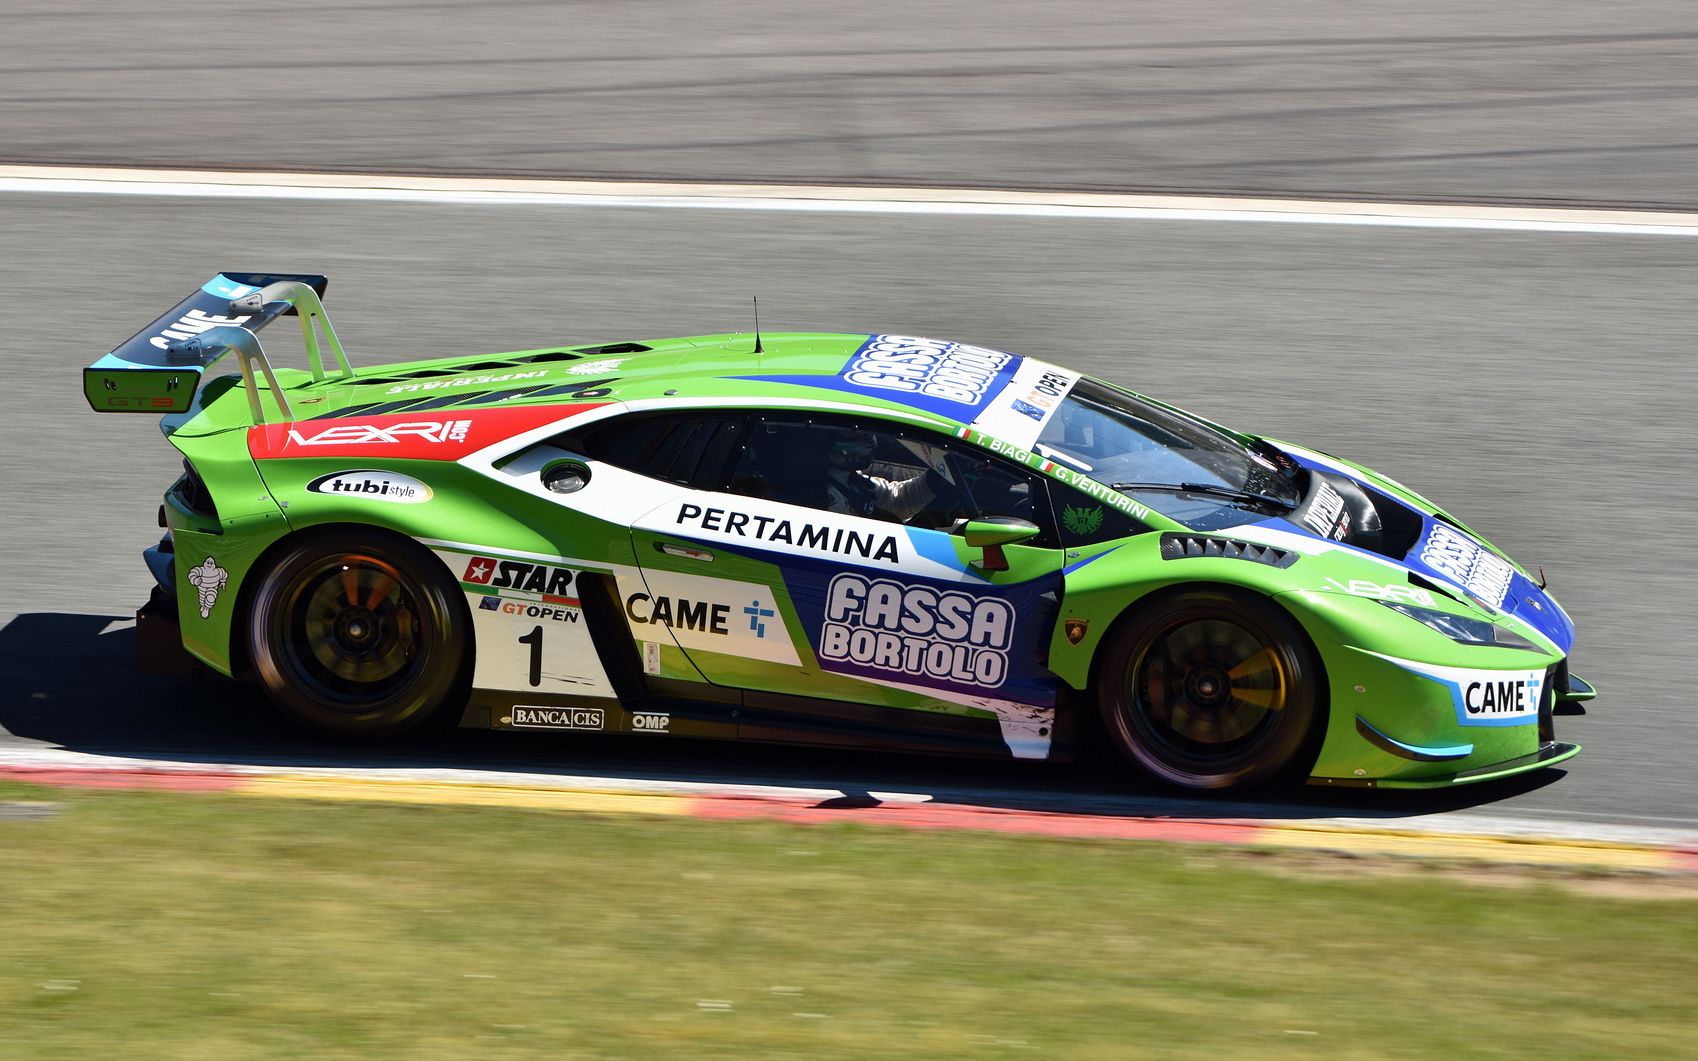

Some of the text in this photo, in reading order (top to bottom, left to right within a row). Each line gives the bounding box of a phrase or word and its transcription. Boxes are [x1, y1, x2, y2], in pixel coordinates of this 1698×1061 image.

[842, 333, 956, 393] FASSA
[920, 344, 1013, 405] BORTOLO
[107, 396, 174, 408] GT3
[975, 434, 1033, 465] T. BIAGI
[332, 479, 416, 499] tubi style
[675, 502, 900, 564] PERTAMINA
[1420, 524, 1480, 586] FASSA
[491, 560, 574, 597] STAR
[625, 592, 731, 636] CAME
[827, 572, 1015, 650] FASSA
[518, 625, 543, 687] 1
[820, 623, 1007, 687] BORTOLO
[514, 709, 571, 725] BANCA
[573, 711, 600, 726] CIS
[1465, 680, 1525, 714] CAME
[632, 714, 670, 730] OMP
